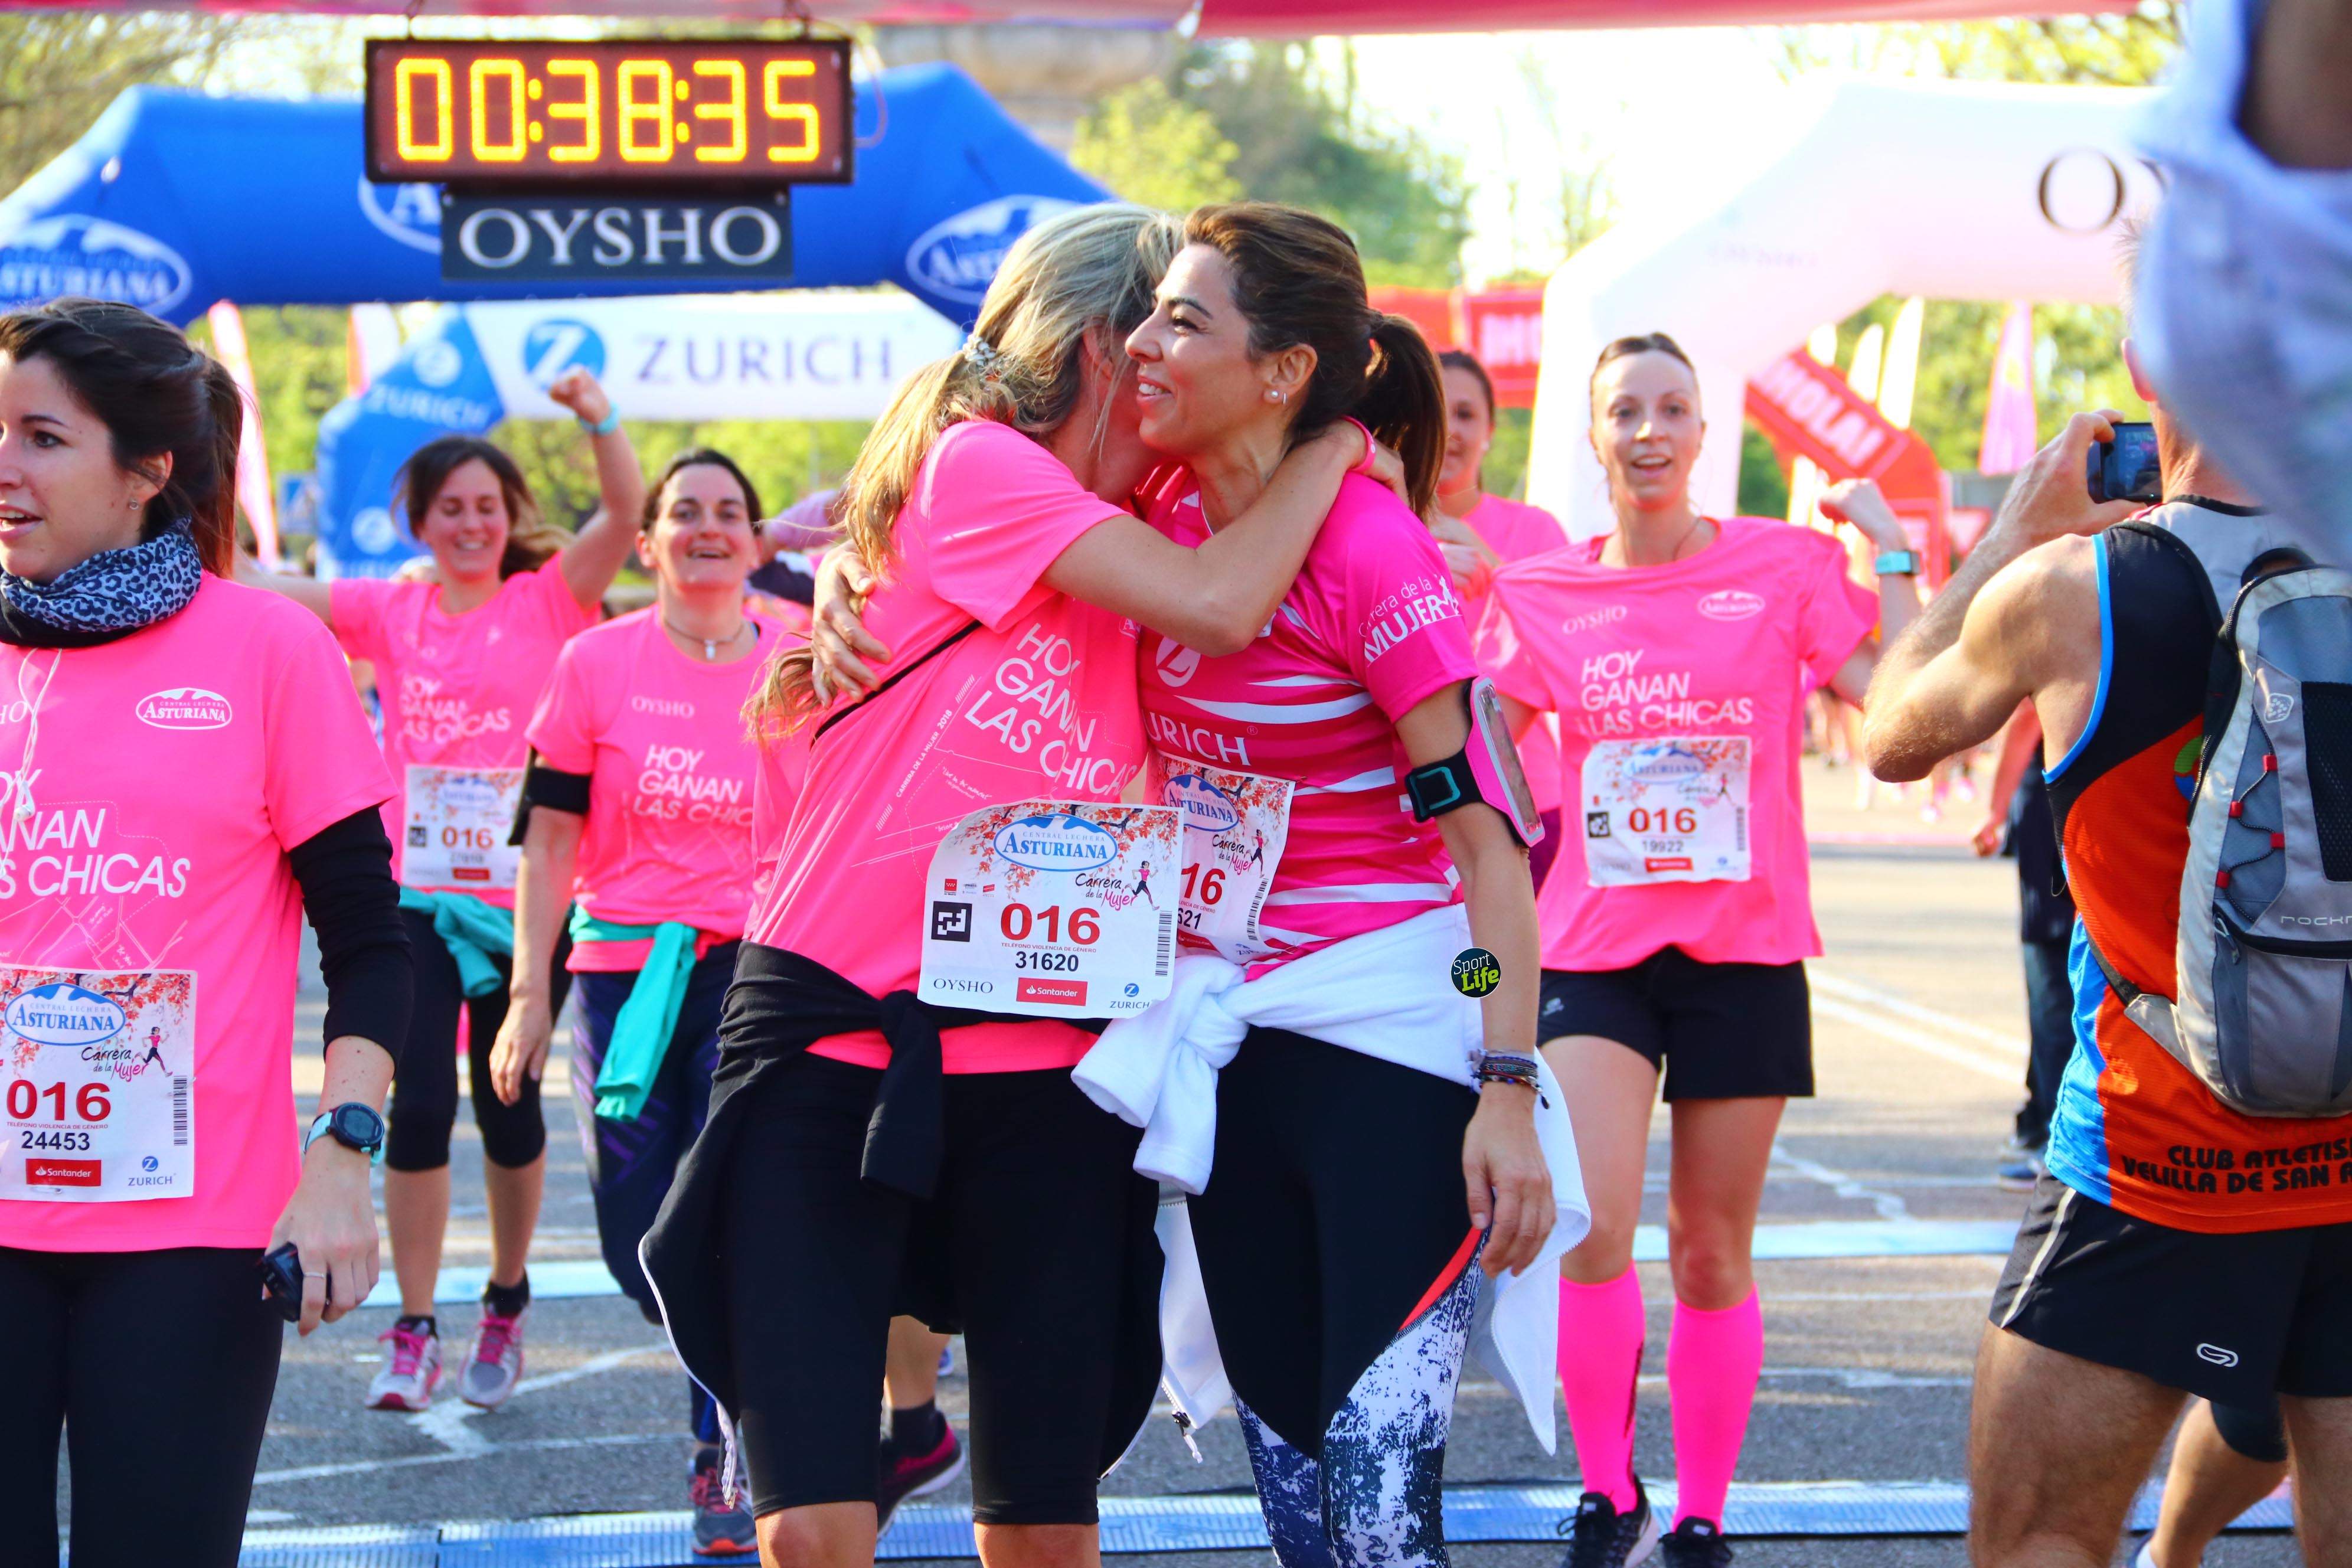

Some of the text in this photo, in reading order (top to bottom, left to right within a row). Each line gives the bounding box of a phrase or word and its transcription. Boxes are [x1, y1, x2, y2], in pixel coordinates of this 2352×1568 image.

[396, 58, 819, 162] 00:38:35
[459, 207, 781, 268] OYSHO
[634, 332, 891, 385] ZURICH
[1401, 582, 1418, 599] de
[1418, 576, 1432, 592] la
[1364, 595, 1446, 662] MUJER
[1563, 605, 1628, 635] OYSHO
[1581, 649, 1644, 684] HOY
[1581, 672, 1690, 711] GANAN
[143, 701, 226, 723] ASTURIANA
[632, 695, 694, 719] OYSHO
[1585, 697, 1753, 736] LAS CHICAS
[964, 690, 1042, 753] LAS
[645, 744, 704, 772] HOY
[896, 709, 953, 798] CARRERA DE LA MUJER 2018
[638, 770, 744, 803] GANAN
[632, 795, 682, 819] LAS
[1629, 807, 1697, 834] 016
[0, 809, 106, 853] NAN
[442, 826, 494, 850] 016
[1022, 831, 1106, 842] CENTRAL LECHERA
[1212, 834, 1245, 854] Carrera
[1002, 831, 1108, 859] ASTURIANA
[1642, 839, 1684, 853] 19922
[28, 854, 191, 898] CHICAS
[1219, 851, 1253, 876] de la Mujer
[1075, 873, 1122, 889] Carrera
[1181, 862, 1226, 905] 16
[1085, 888, 1138, 912] de la Mujer
[1001, 903, 1100, 945] 016
[1015, 950, 1079, 972] 31620
[933, 978, 994, 994] OYSHO
[1037, 986, 1078, 998] Santander
[12, 1004, 116, 1031] ASTURIANA
[30, 1002, 112, 1013] CENTRAL LECHERA
[1110, 1001, 1151, 1010] ZURICH
[81, 1047, 132, 1061] Carrera
[93, 1059, 149, 1082] de la Mujer
[6, 1079, 112, 1122] 016
[21, 1131, 90, 1151] 24453
[2168, 1138, 2352, 1170] CLUB ATLETIS
[47, 1168, 92, 1177] Santander
[128, 1175, 172, 1186] ZURICH
[2121, 1155, 2217, 1193] VELILLA
[2227, 1172, 2263, 1194] DE
[2273, 1165, 2329, 1191] SAN
